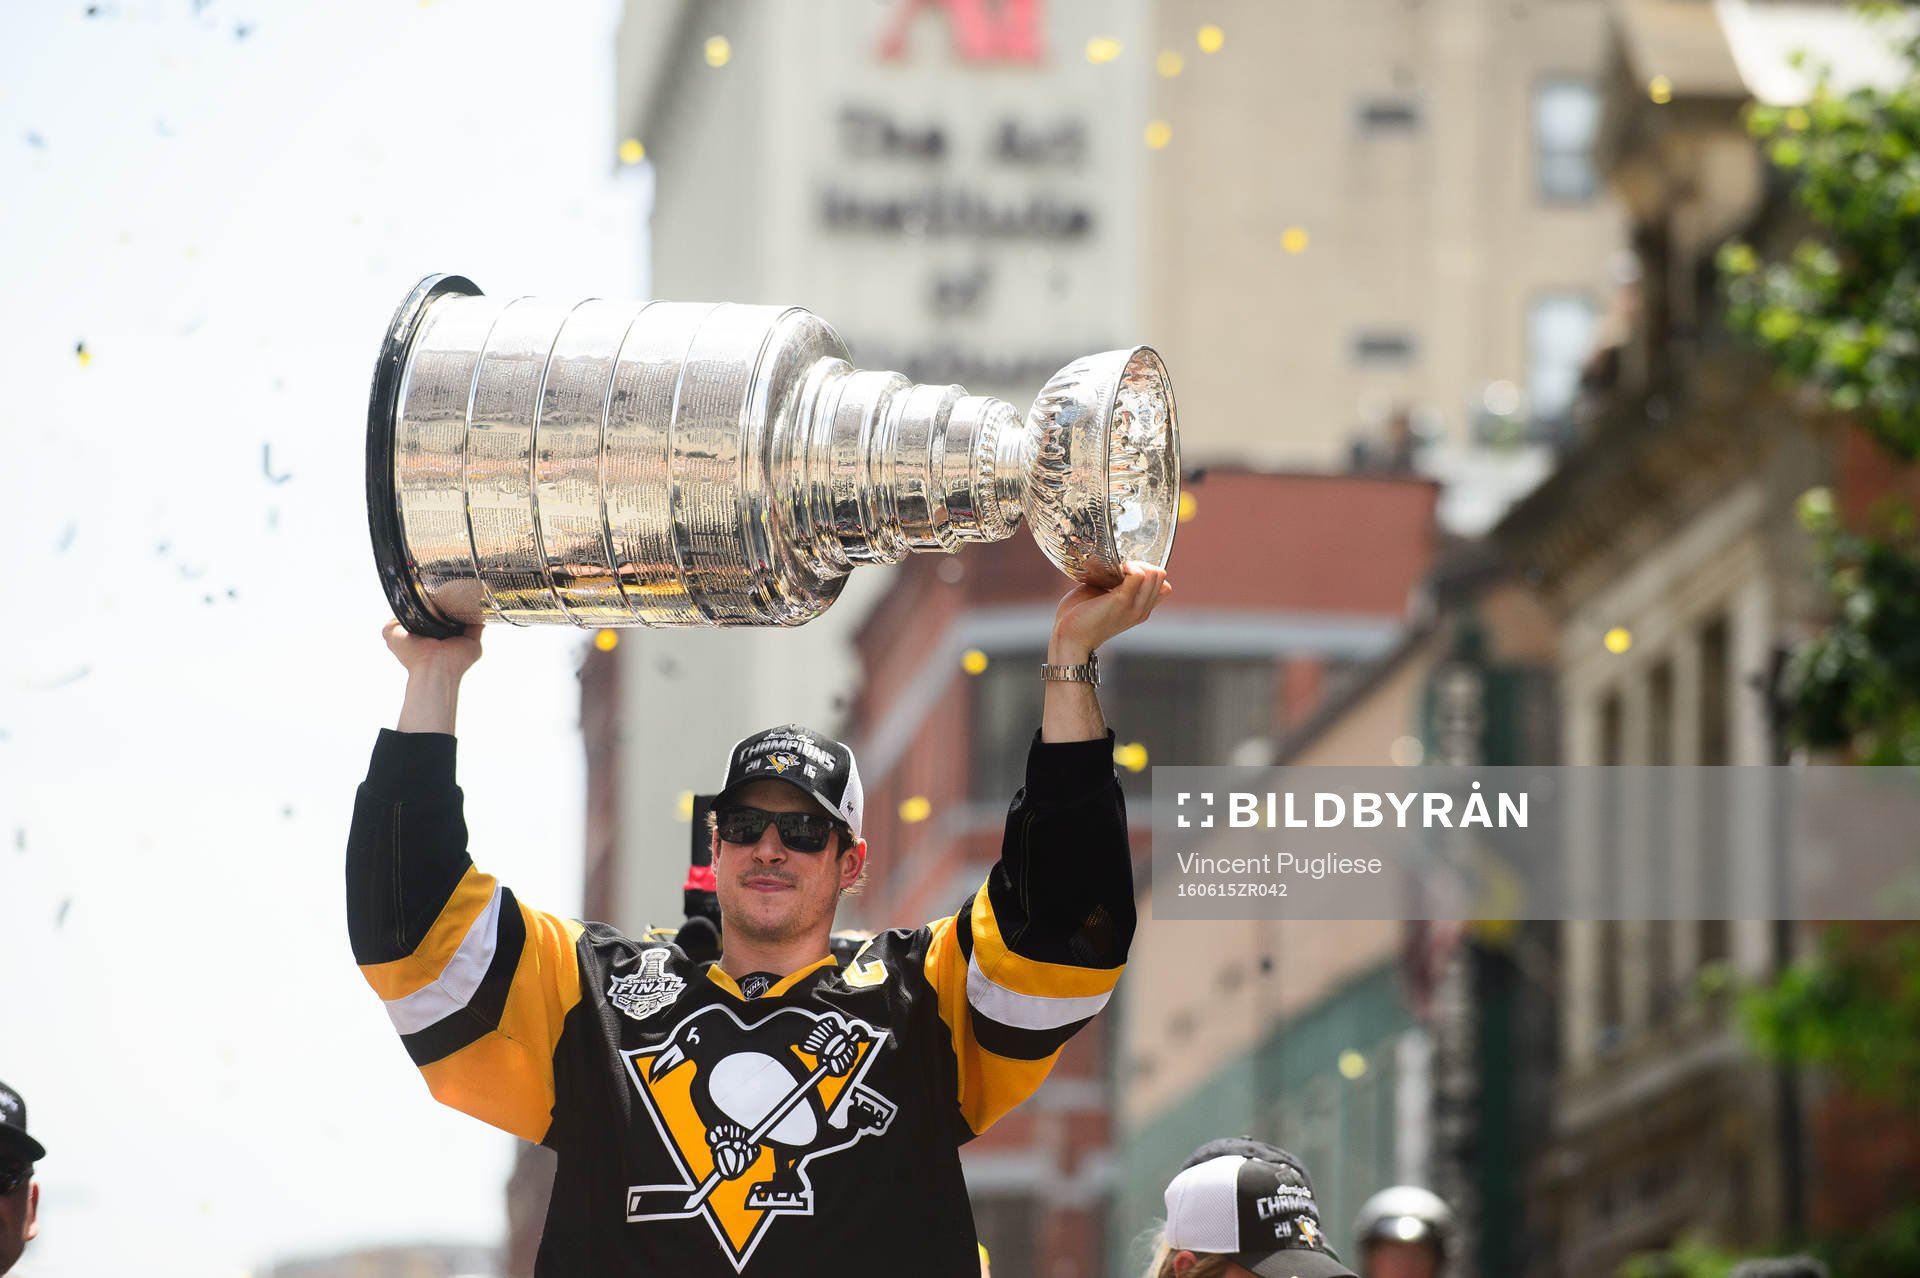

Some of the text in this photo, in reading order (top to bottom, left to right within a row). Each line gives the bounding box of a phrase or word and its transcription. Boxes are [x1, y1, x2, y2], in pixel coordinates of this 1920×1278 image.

[739, 739, 837, 775] CHAMPIONS
[842, 939, 889, 988] C
[616, 981, 679, 994] FINAL
[746, 980, 762, 997] NHL
